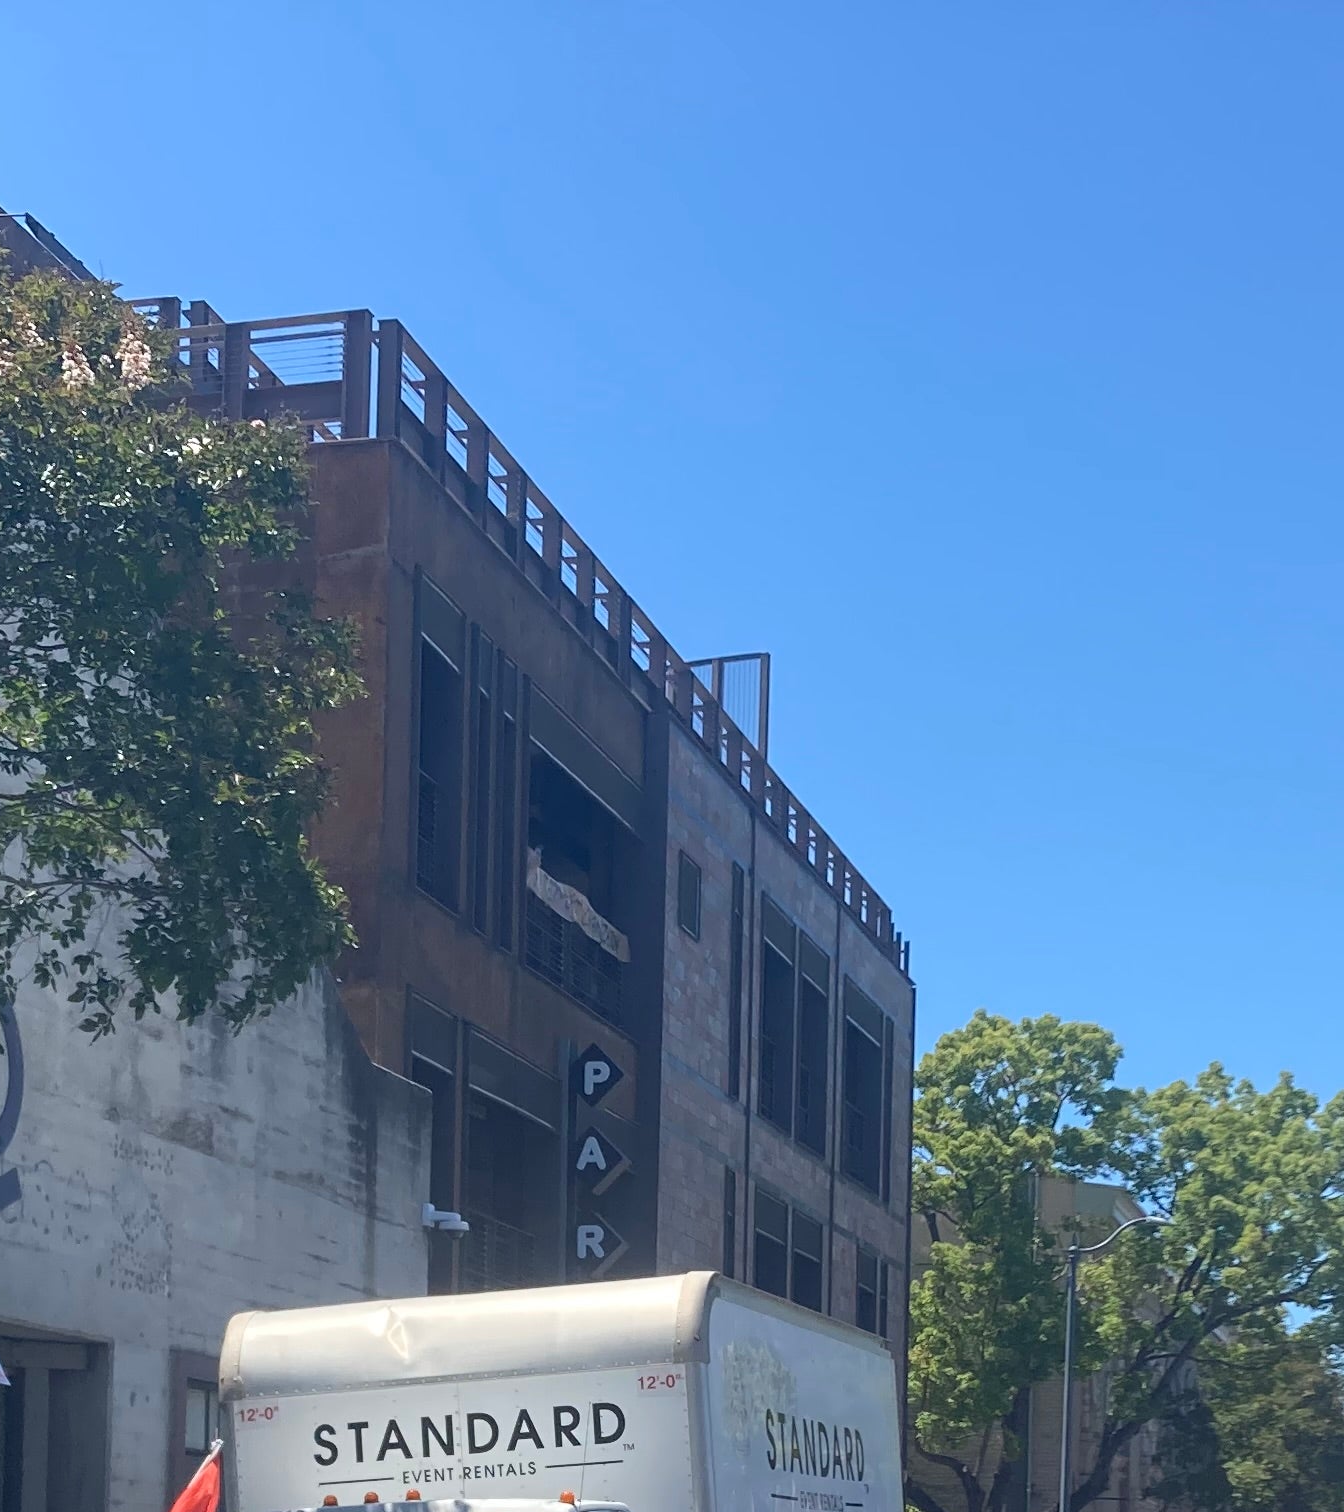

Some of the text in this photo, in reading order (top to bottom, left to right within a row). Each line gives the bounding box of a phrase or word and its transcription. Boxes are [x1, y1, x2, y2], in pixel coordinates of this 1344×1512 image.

[313, 1402, 626, 1466] STANDARD
[766, 1408, 865, 1481] STANDARD
[402, 1461, 537, 1484] EVENT RENTALS
